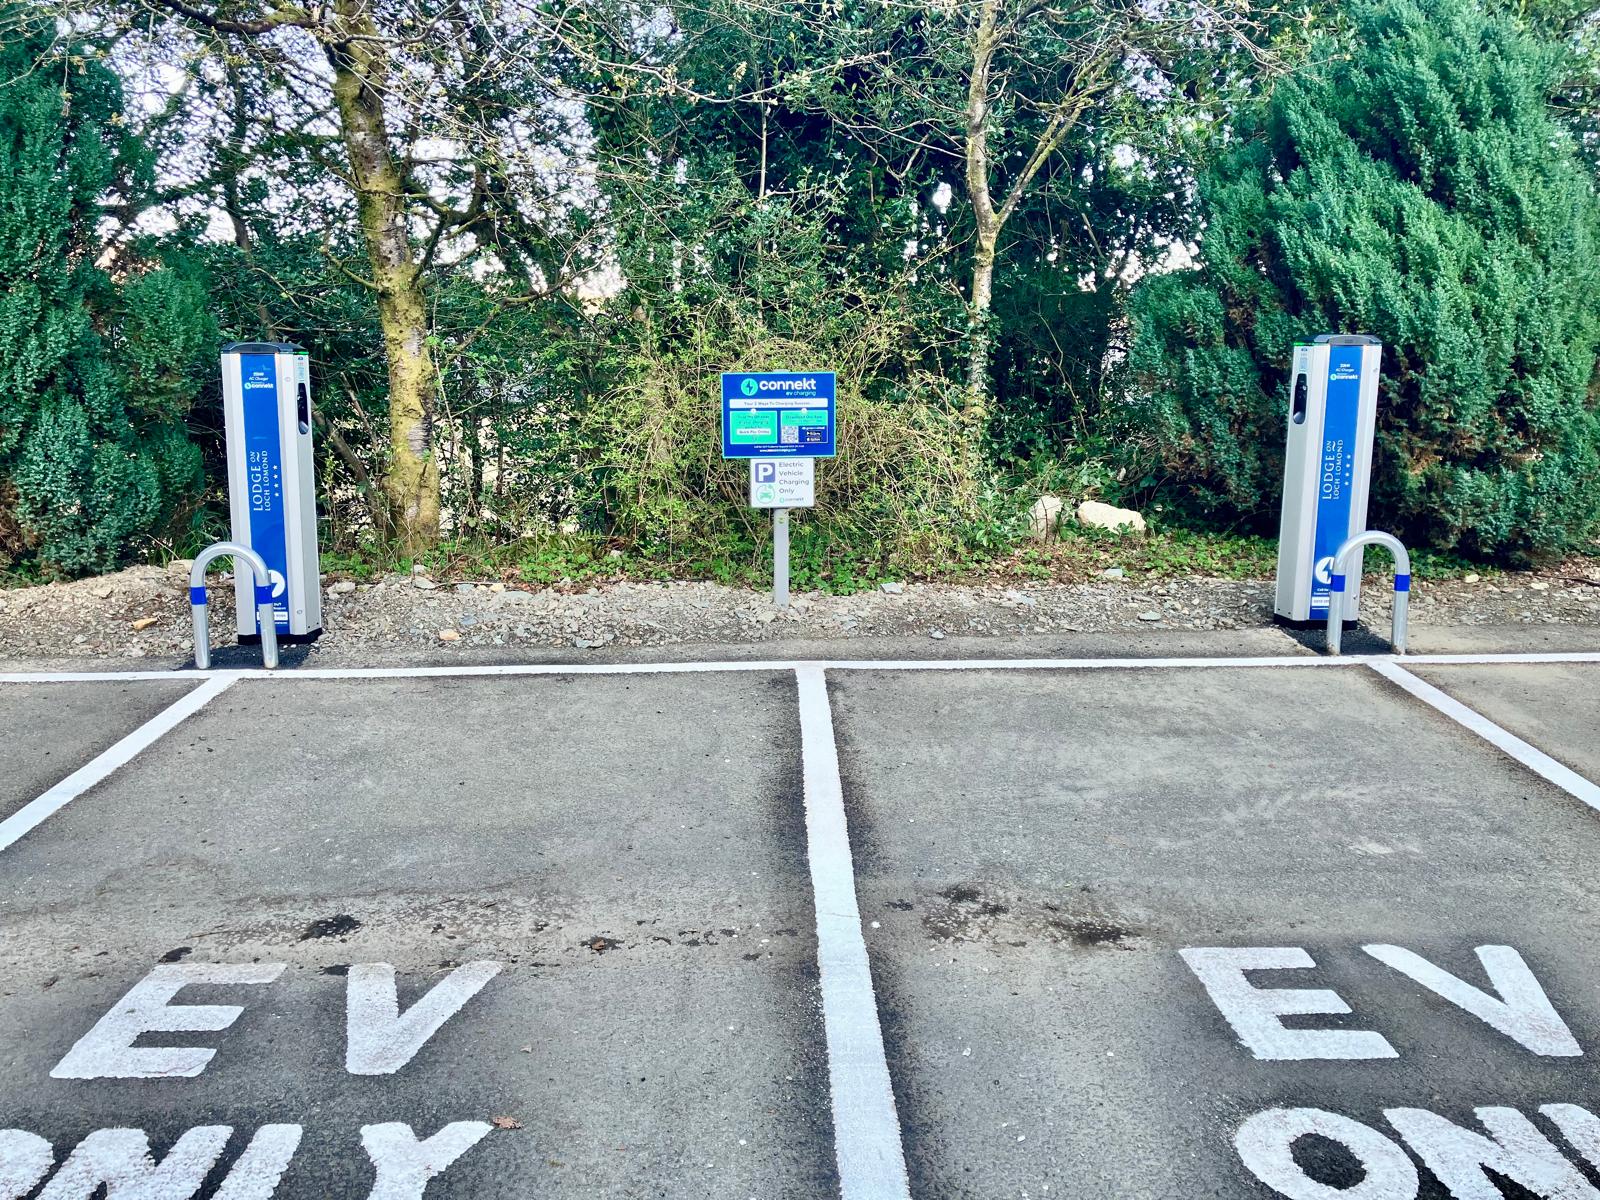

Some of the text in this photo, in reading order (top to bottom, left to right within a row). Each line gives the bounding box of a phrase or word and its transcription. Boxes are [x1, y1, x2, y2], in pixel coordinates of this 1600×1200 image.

[759, 377, 816, 390] connekt
[250, 451, 263, 512] LODGE ON
[262, 451, 270, 486] LOMOND
[758, 464, 773, 481] P
[1322, 440, 1335, 500] LODGE ON
[1335, 440, 1343, 476] LOMOND
[50, 961, 502, 1079] EV
[1178, 944, 1584, 1061] EV
